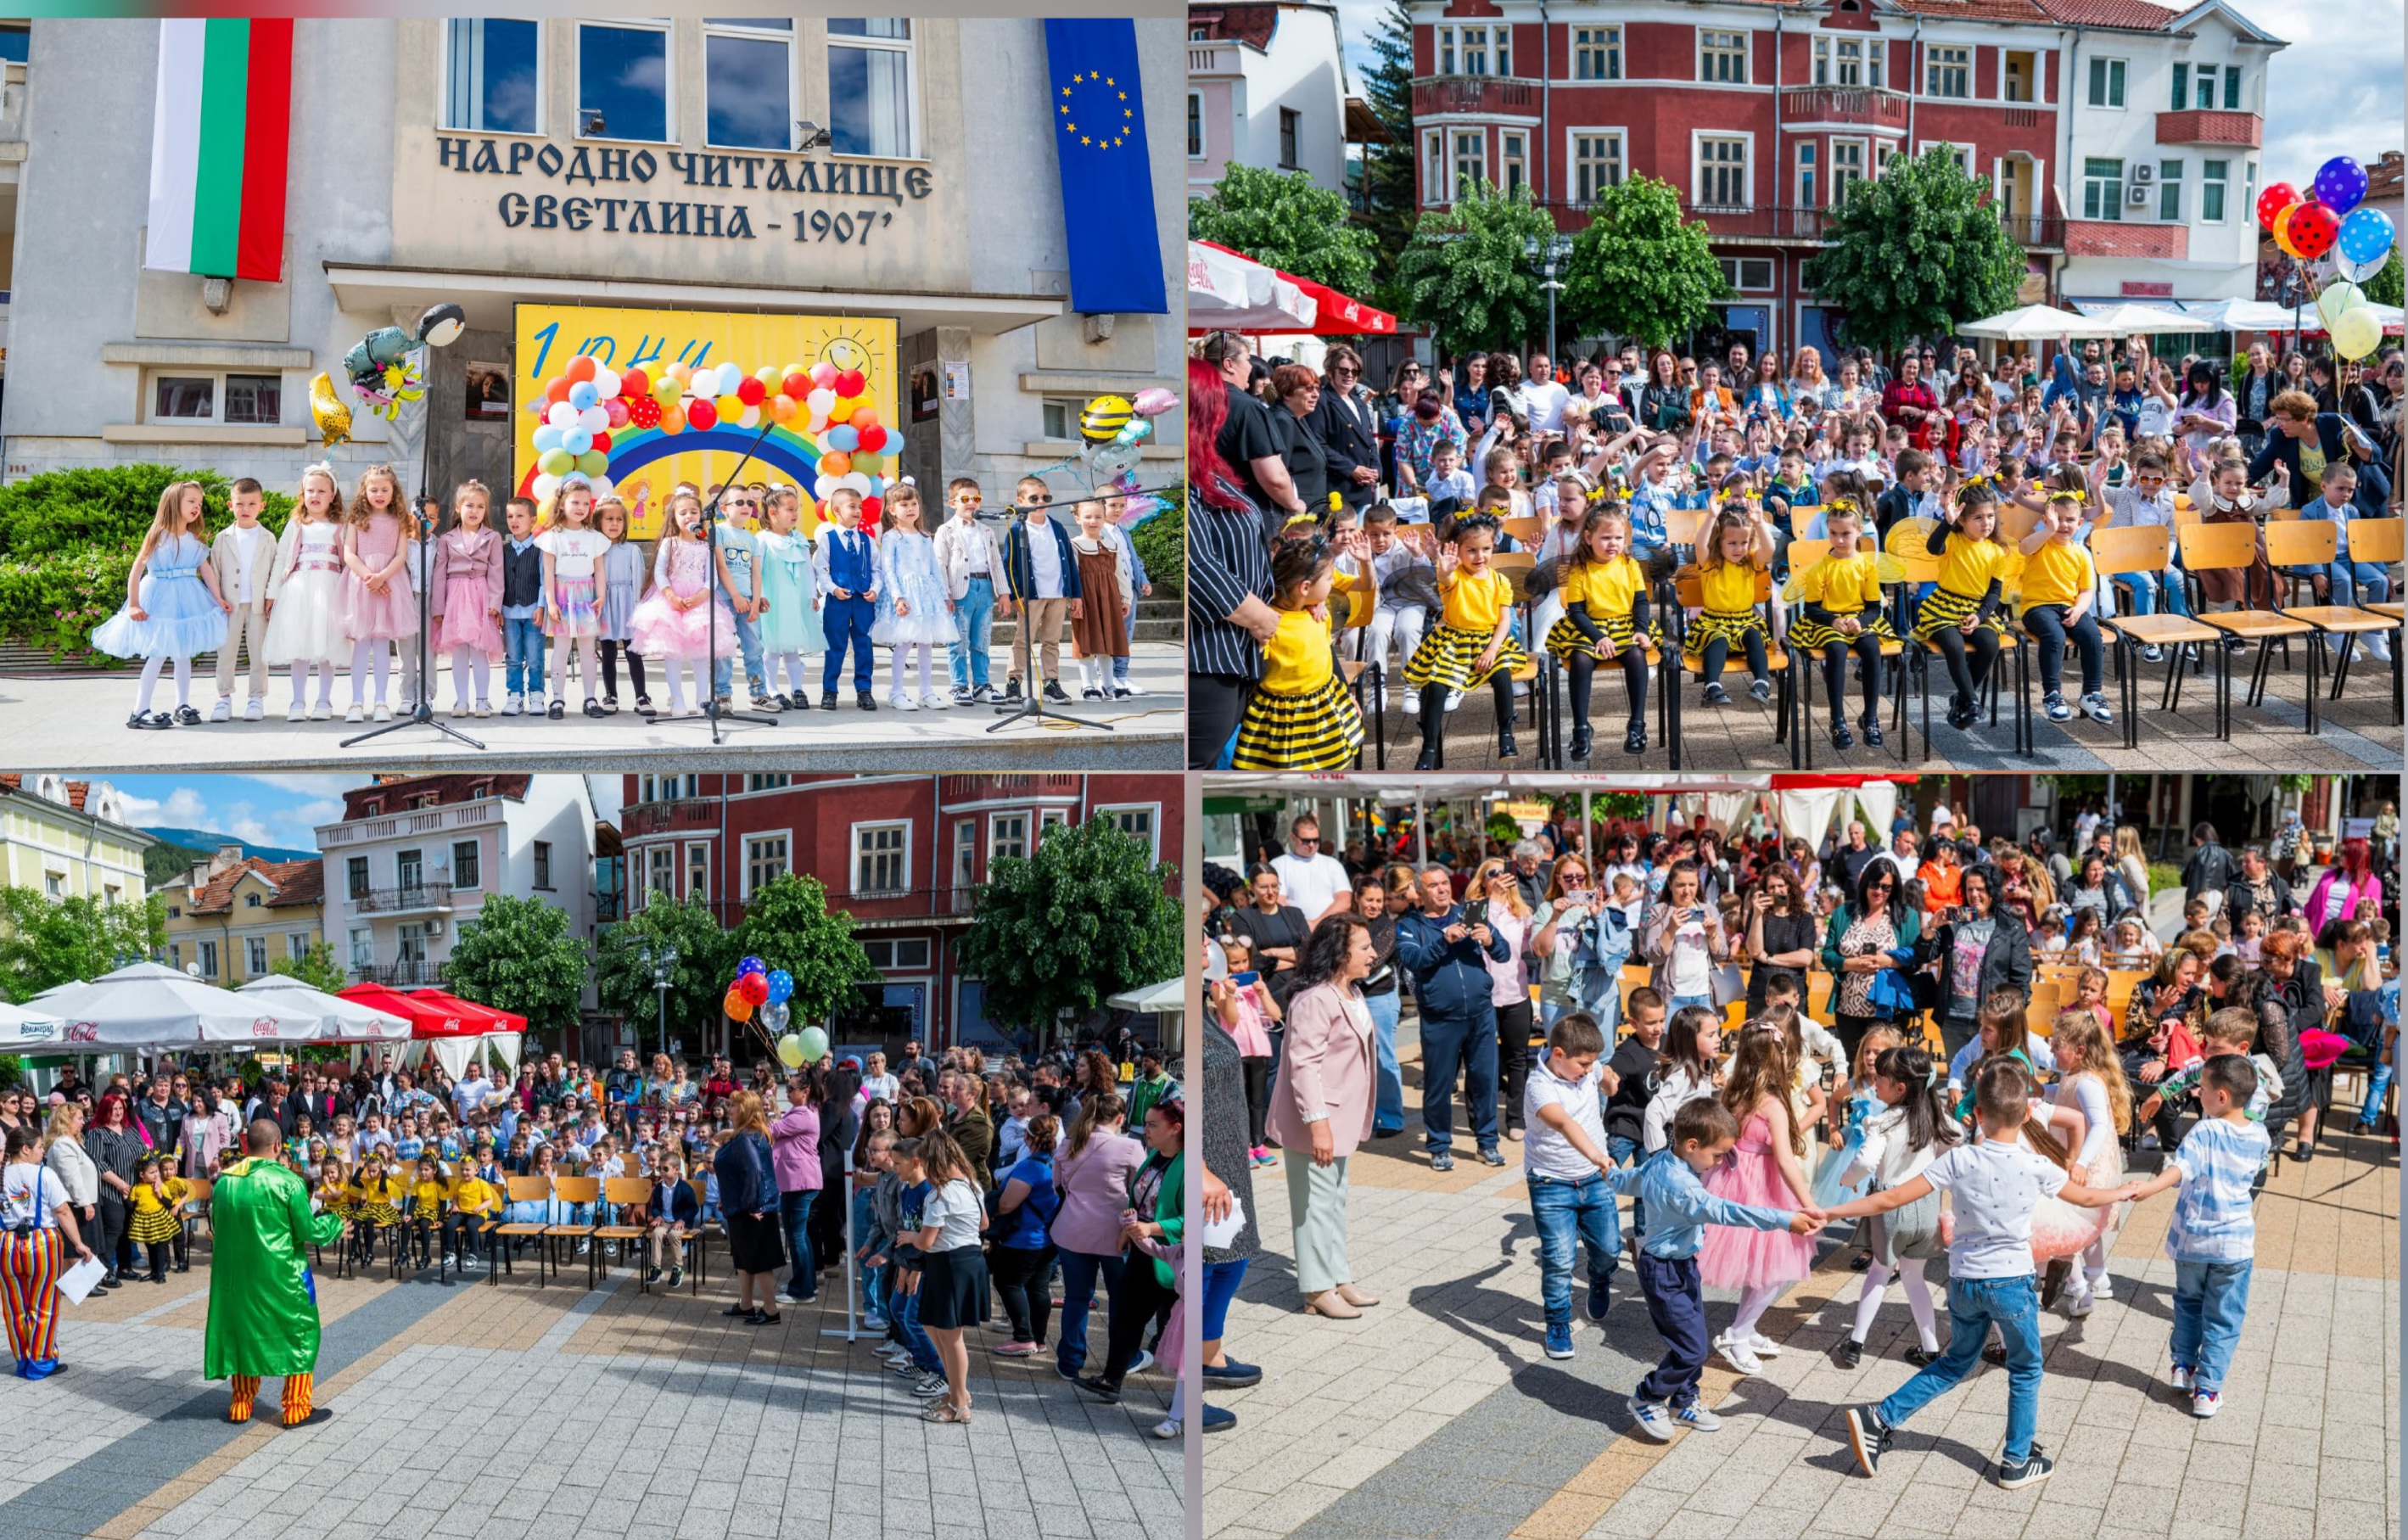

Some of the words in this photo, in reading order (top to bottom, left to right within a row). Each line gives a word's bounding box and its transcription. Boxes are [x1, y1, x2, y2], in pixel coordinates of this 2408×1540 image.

[436, 137, 658, 188] НАРОДНО
[668, 151, 934, 206] ЧИТАЛИЩЕ
[498, 192, 757, 239] СВЕТЛИНА
[532, 322, 560, 379] 1
